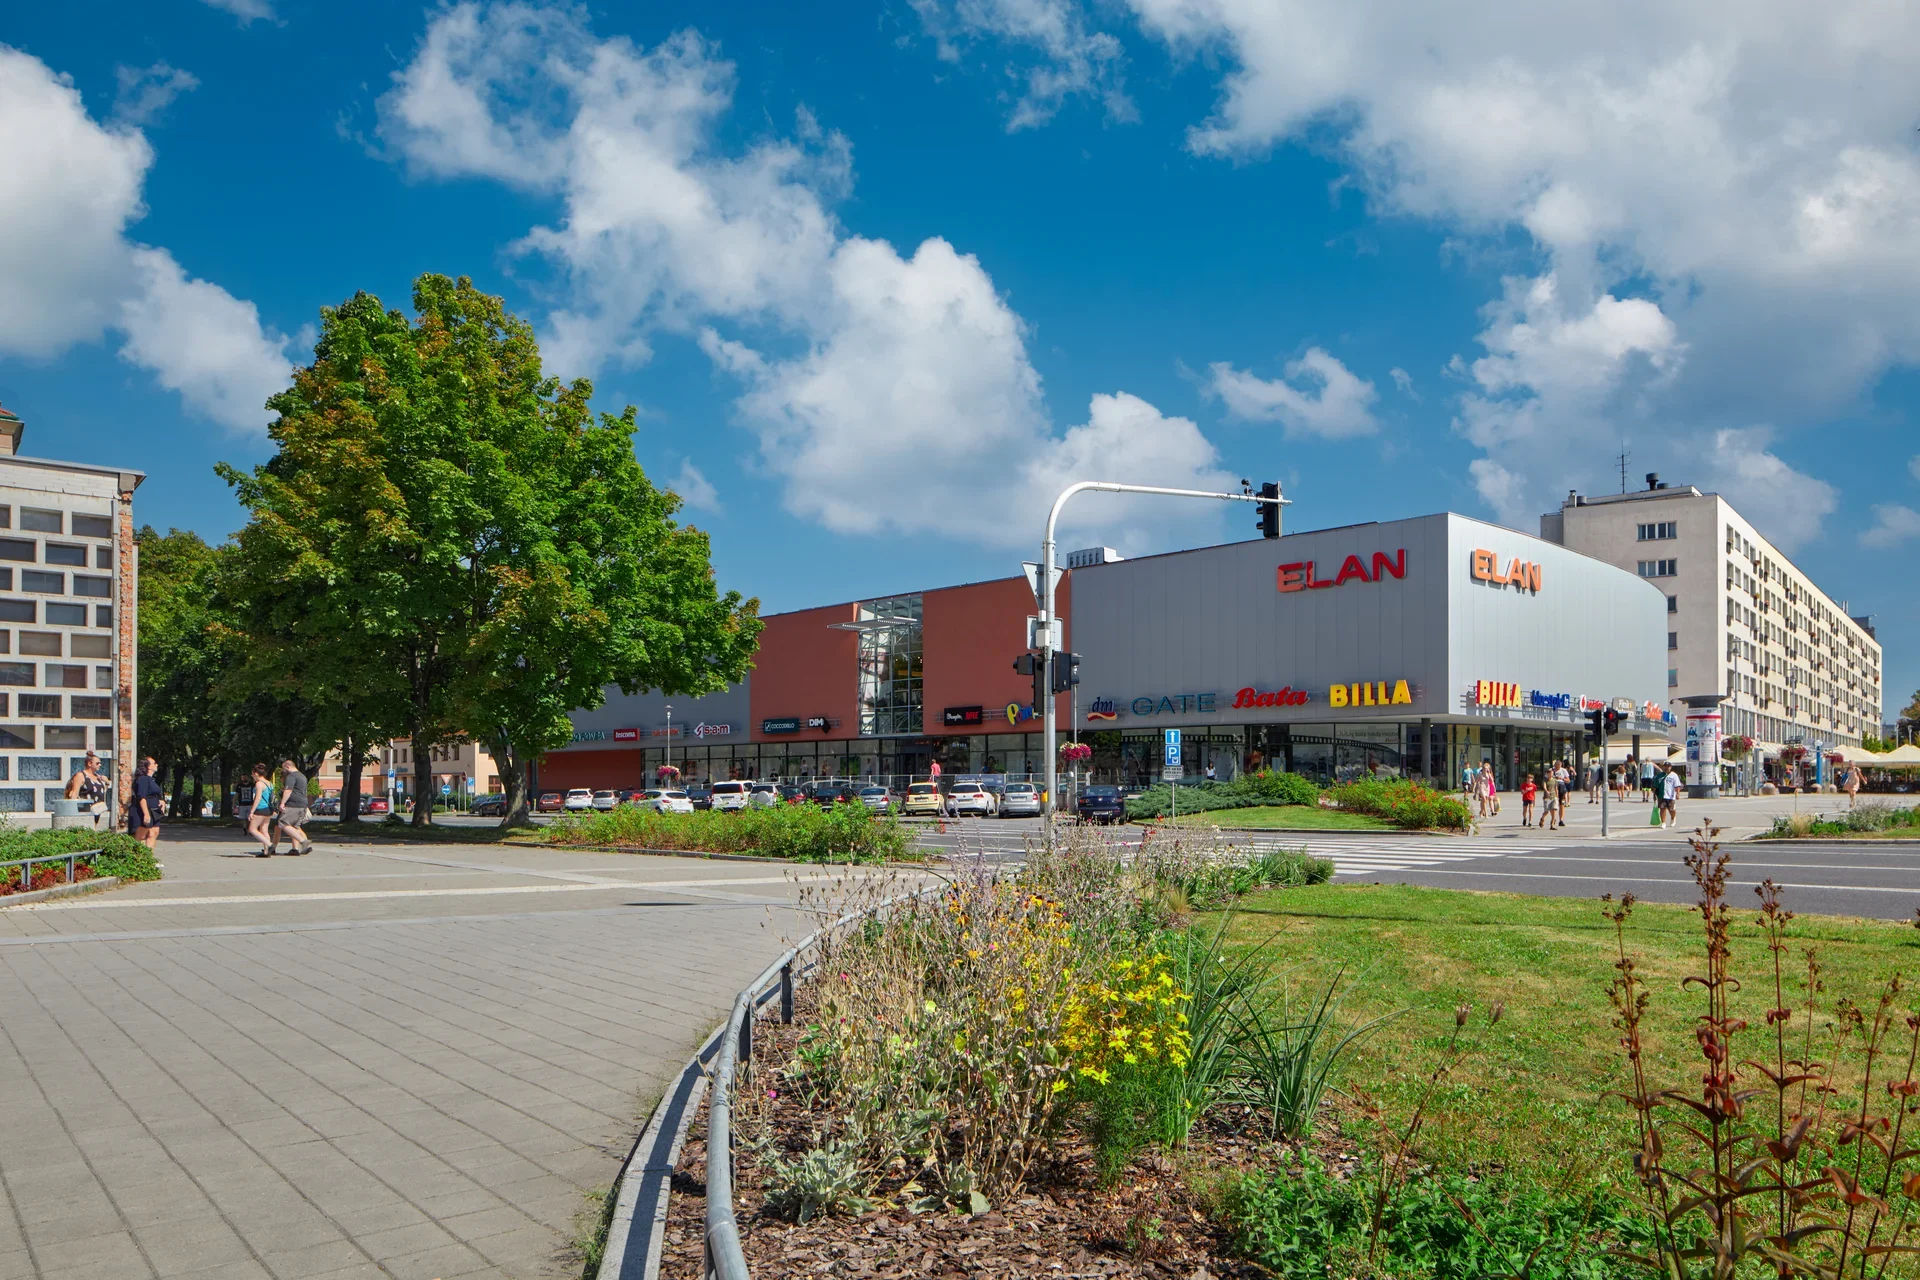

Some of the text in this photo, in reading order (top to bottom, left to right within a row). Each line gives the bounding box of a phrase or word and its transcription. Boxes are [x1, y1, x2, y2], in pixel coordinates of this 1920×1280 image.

[1277, 548, 1406, 593] ELAN
[1474, 548, 1542, 592] ELAN
[1092, 696, 1114, 713] dm
[1131, 693, 1216, 716] GATE
[1329, 679, 1412, 708] BILLA
[1476, 680, 1522, 708] BILLA
[808, 718, 825, 727] DIM
[1168, 746, 1178, 759] P
